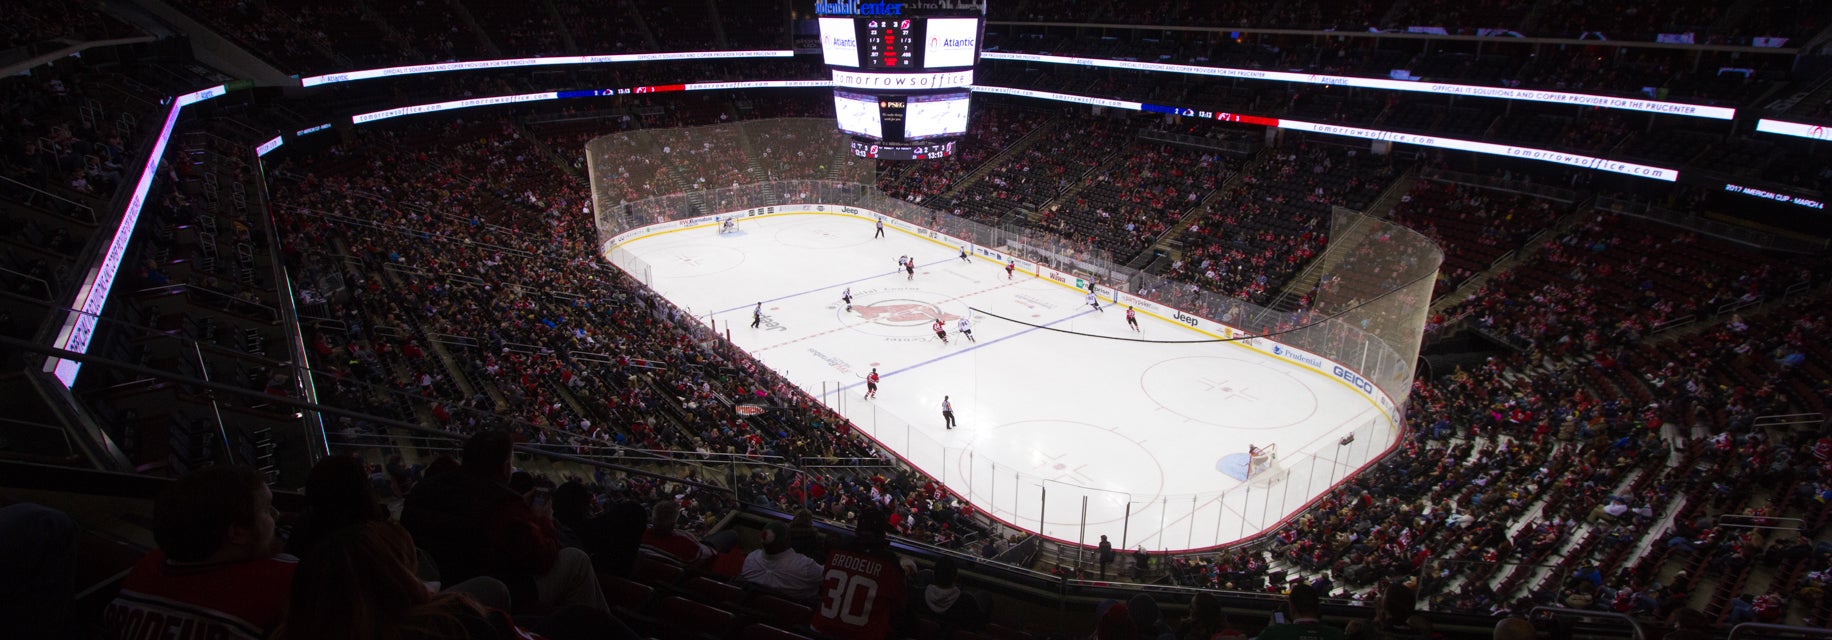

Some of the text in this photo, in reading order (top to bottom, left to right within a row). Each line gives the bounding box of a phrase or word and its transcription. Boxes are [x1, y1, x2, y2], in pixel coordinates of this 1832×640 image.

[834, 38, 856, 48] Atlantic
[943, 38, 975, 48] Atlantic
[1321, 76, 1349, 84] Atlantic
[360, 94, 548, 121] tomorrowsoffice.com tomorrowsoffice.com
[1052, 94, 1122, 106] tomorrowsoffice.com
[1432, 85, 1463, 93] OFFICIAL
[1473, 88, 1514, 97] SOLUTIONS
[1536, 92, 1567, 101] COPIER
[1568, 95, 1608, 104] PROVIDER
[1610, 99, 1627, 107] FOR
[1629, 101, 1643, 109] THE
[1645, 103, 1696, 113] PRUCENTER
[1313, 124, 1434, 144] tomorrowsoffice.com
[928, 151, 943, 160] 13:13
[1507, 147, 1662, 177] tomorrowsoffice.com
[1725, 184, 1743, 192] 2017
[1743, 187, 1775, 200] AMERICAN
[1775, 194, 1790, 202] CUP
[1793, 197, 1818, 208] MARCH
[841, 206, 858, 216] Jeep
[1173, 310, 1198, 327] Jeep
[1285, 349, 1322, 368] Prudential
[1333, 365, 1373, 395] GEICO
[831, 553, 882, 577] BRODEUR
[820, 568, 879, 627] 30
